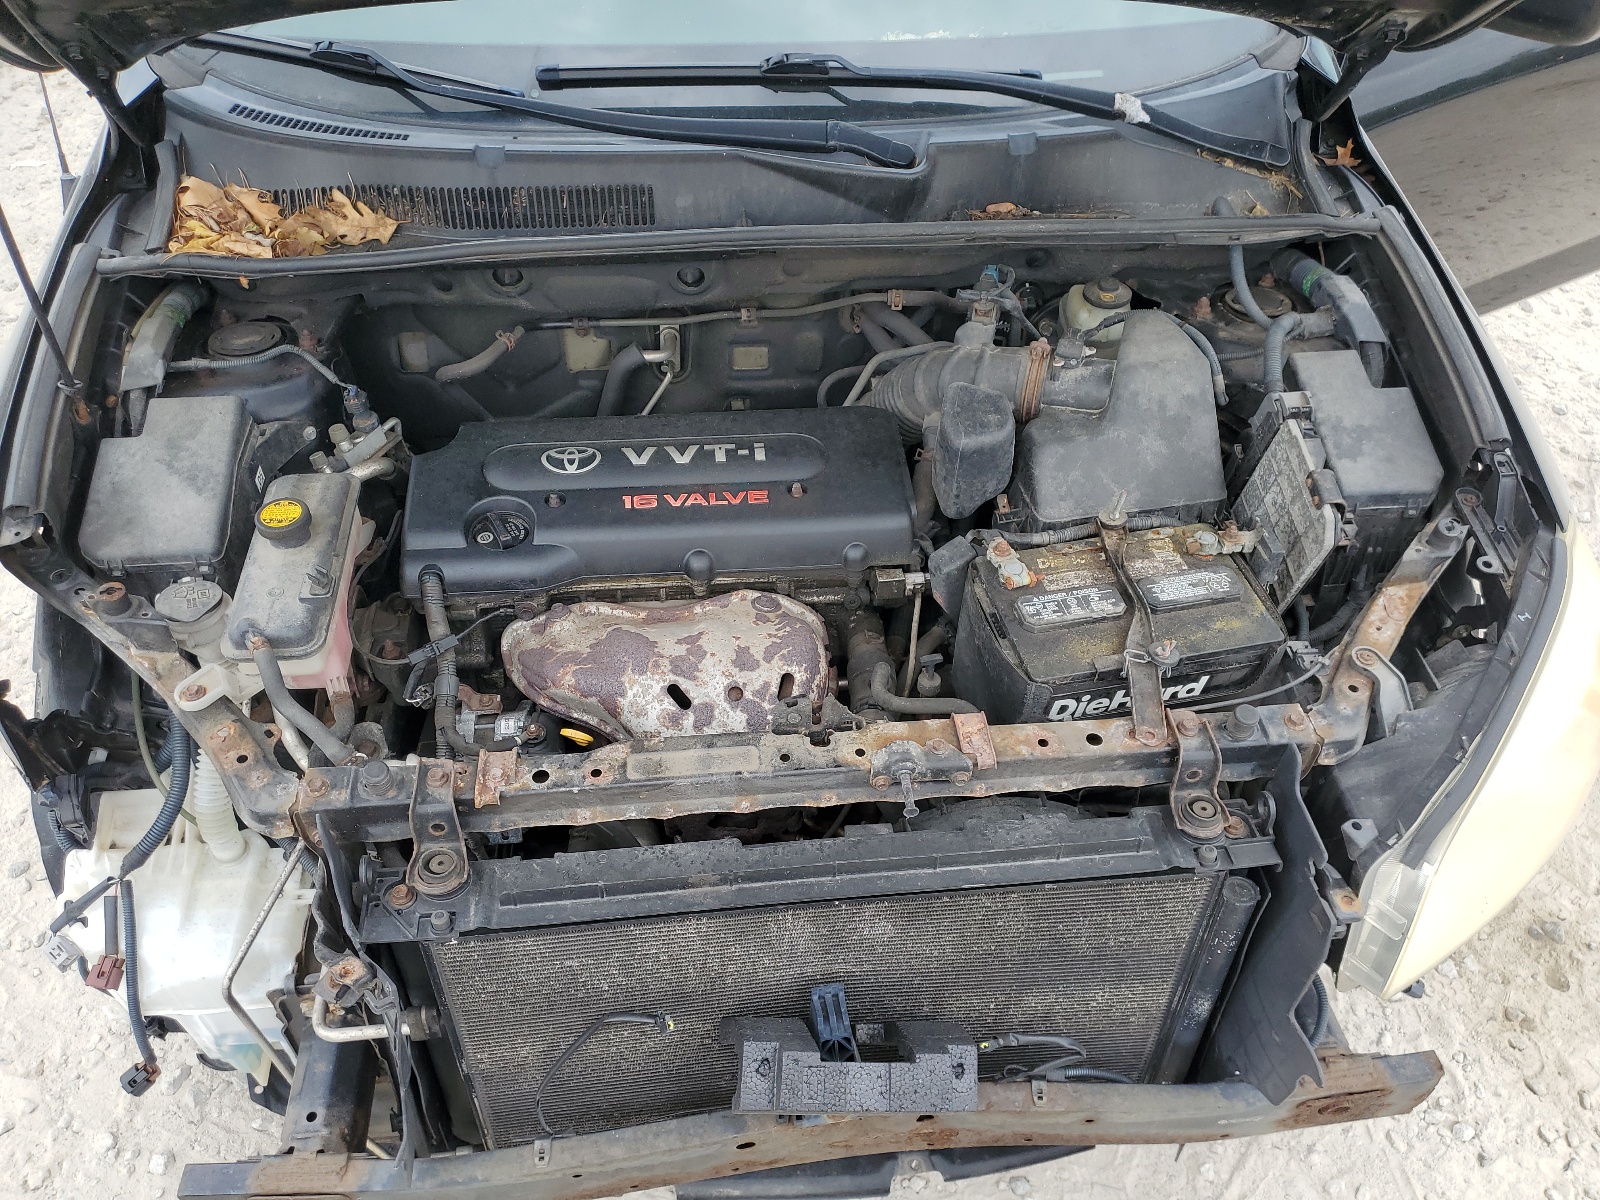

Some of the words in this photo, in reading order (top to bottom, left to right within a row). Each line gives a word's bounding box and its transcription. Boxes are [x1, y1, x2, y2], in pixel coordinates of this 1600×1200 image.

[620, 443, 767, 466] VVT-i
[622, 494, 658, 509] 16
[663, 490, 769, 507] VALVE
[1038, 592, 1068, 601] DANGER
[1072, 587, 1099, 596] POISON
[1049, 675, 1210, 721] DieHrd
